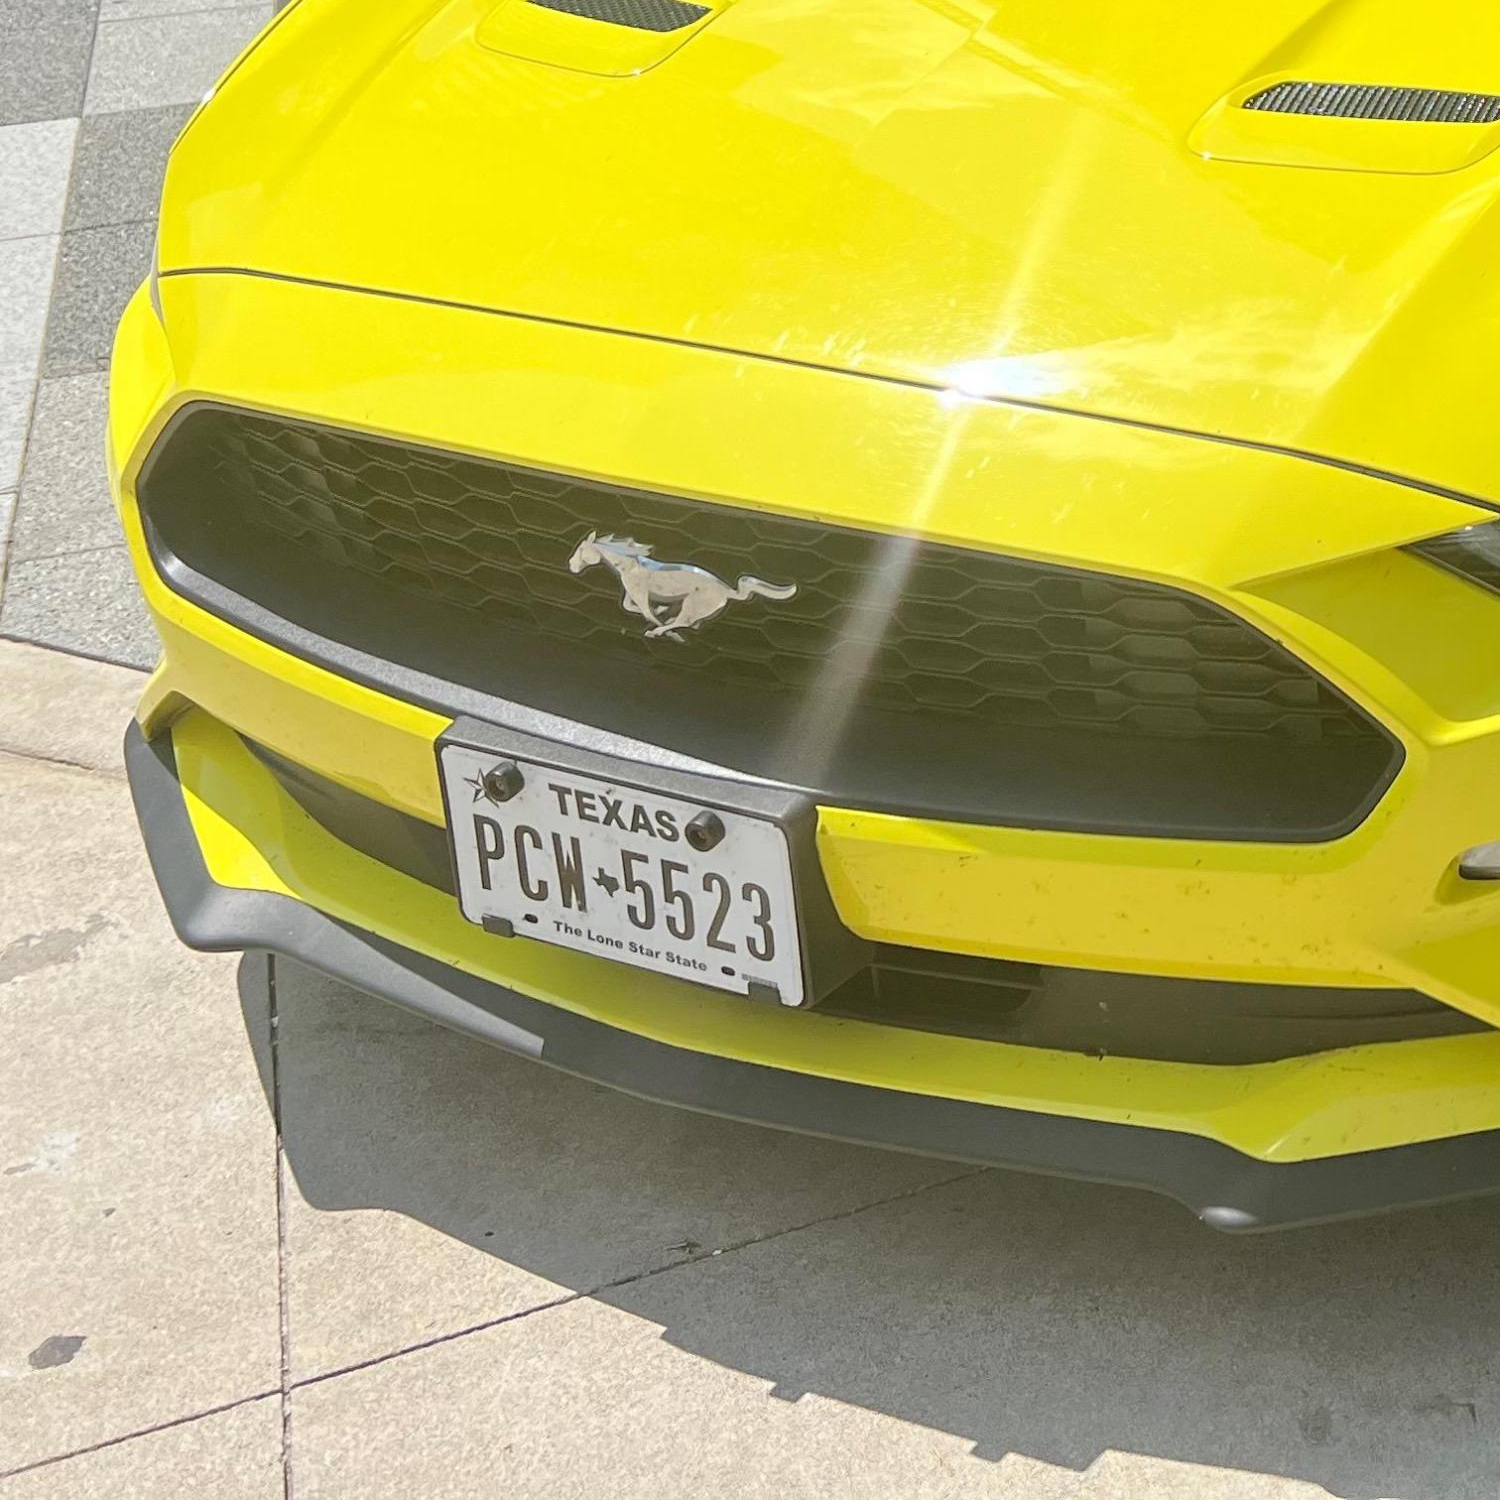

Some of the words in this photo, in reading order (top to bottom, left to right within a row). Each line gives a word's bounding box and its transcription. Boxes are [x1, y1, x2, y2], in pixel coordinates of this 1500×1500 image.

[548, 782, 681, 843] TEXAS
[553, 921, 582, 938] The
[587, 929, 624, 950] Lone
[628, 940, 661, 960] Star
[665, 950, 708, 972] State
